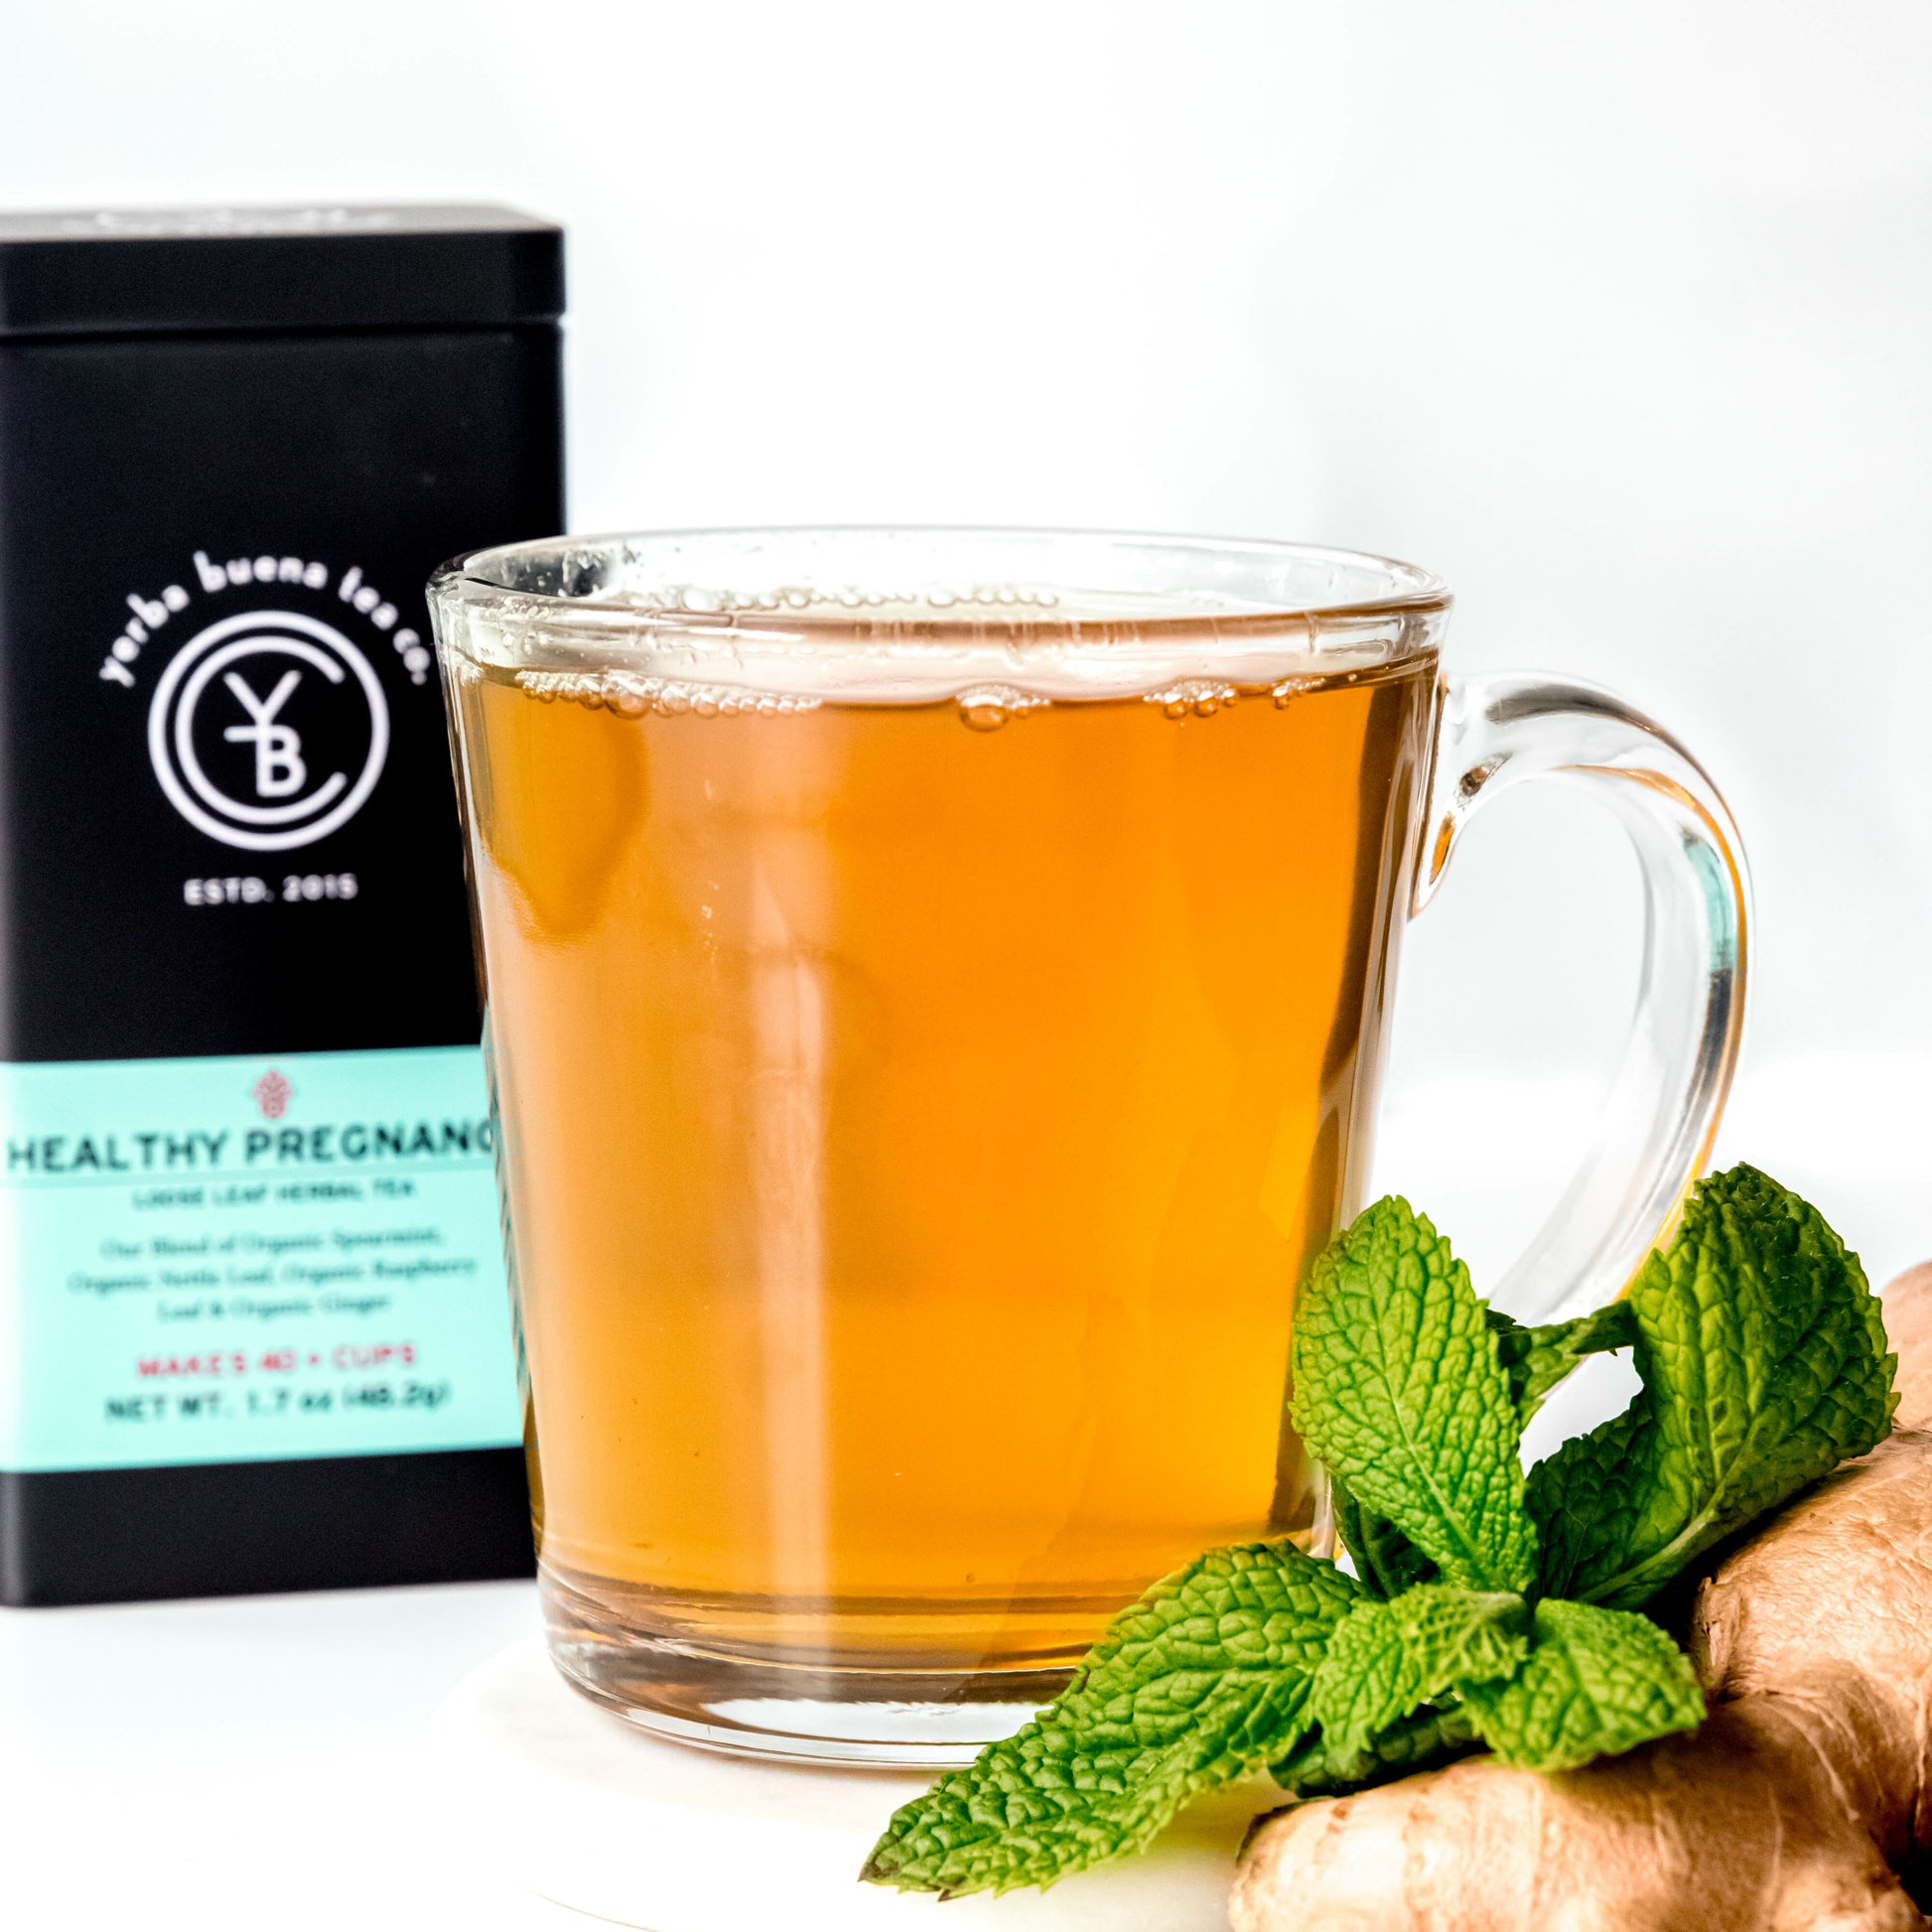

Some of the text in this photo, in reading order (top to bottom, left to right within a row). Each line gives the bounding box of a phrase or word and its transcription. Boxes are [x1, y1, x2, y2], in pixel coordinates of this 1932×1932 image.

[194, 550, 329, 593] buena
[282, 873, 358, 902] 2015
[8, 1130, 229, 1173] HEALTHY
[213, 1183, 267, 1206] LEAF
[275, 1181, 363, 1202] HERBAL
[373, 1177, 415, 1197] TEA
[137, 1353, 247, 1378] MAKES
[333, 1344, 416, 1369] CUPS
[105, 1395, 167, 1423] NET
